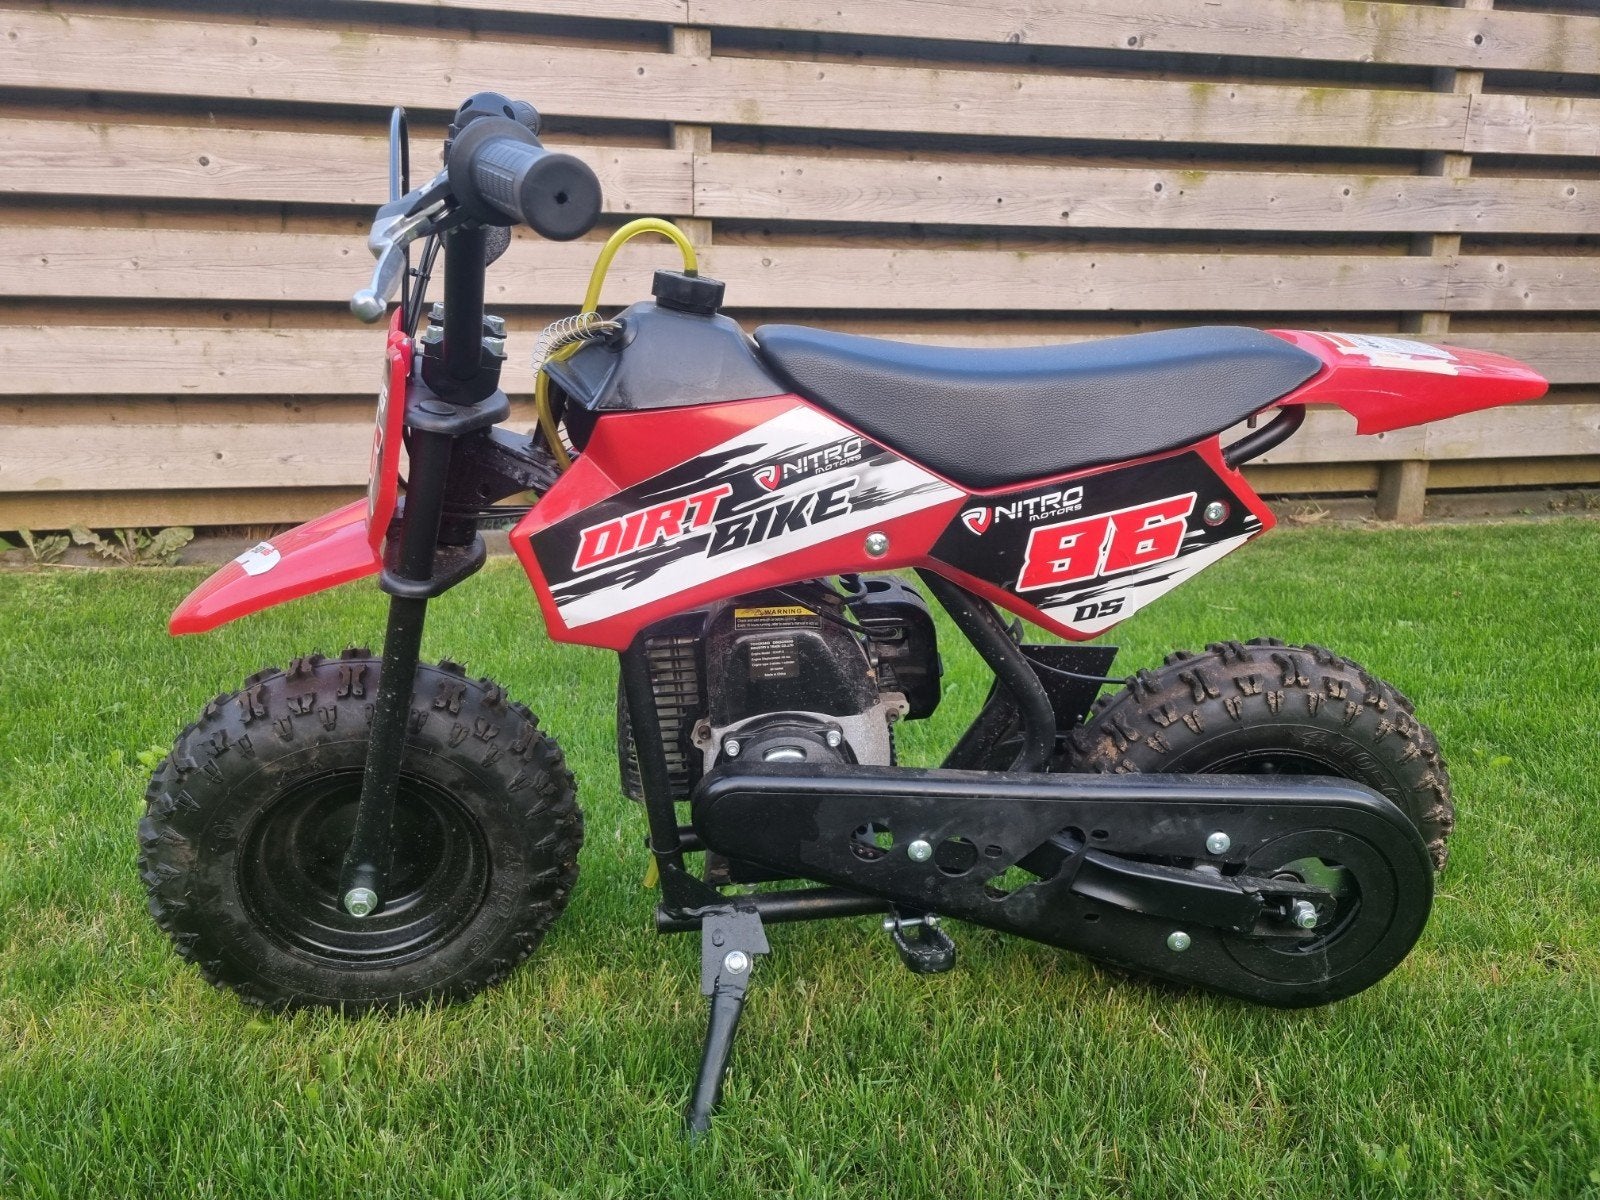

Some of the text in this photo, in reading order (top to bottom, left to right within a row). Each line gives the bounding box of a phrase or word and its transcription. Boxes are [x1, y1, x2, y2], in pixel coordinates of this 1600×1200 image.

[783, 438, 862, 479] NITRO
[815, 454, 862, 475] MOTORS
[706, 478, 859, 559] BIKE
[994, 486, 1084, 524] NITRO
[1029, 504, 1083, 522] MOTORS
[572, 484, 733, 572] DIRT
[1016, 492, 1197, 592] 86
